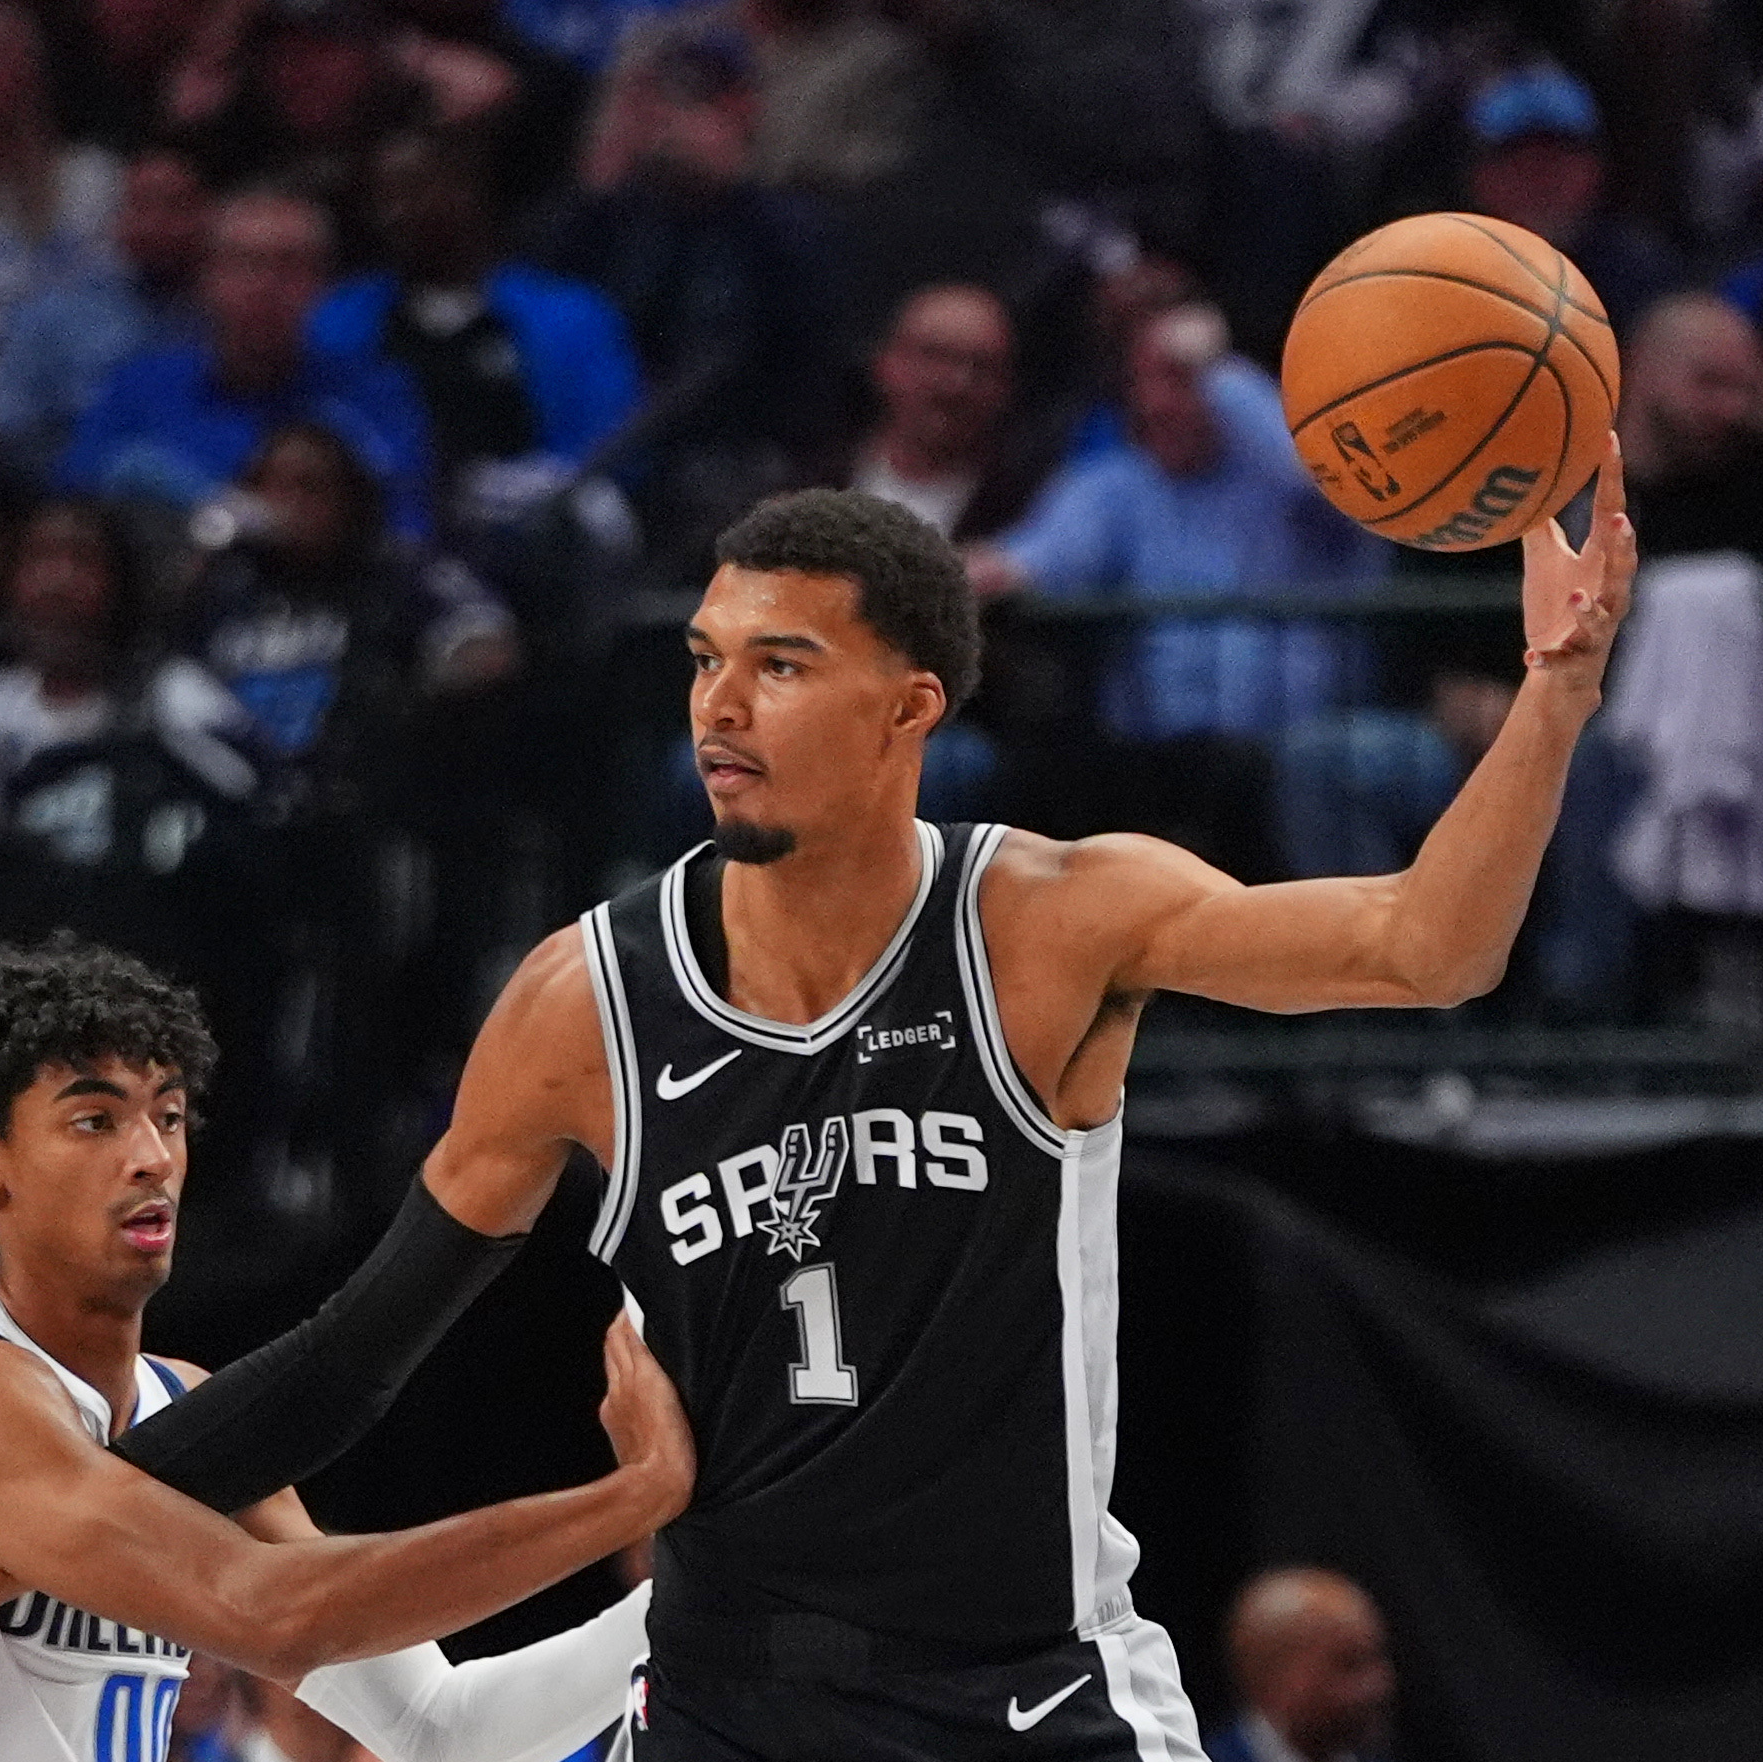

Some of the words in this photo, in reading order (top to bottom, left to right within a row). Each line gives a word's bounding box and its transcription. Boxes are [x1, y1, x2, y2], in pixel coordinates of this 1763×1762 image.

[868, 1023, 942, 1051] LEDGER
[660, 1108, 989, 1267] SPURS
[779, 1262, 858, 1406] 1
